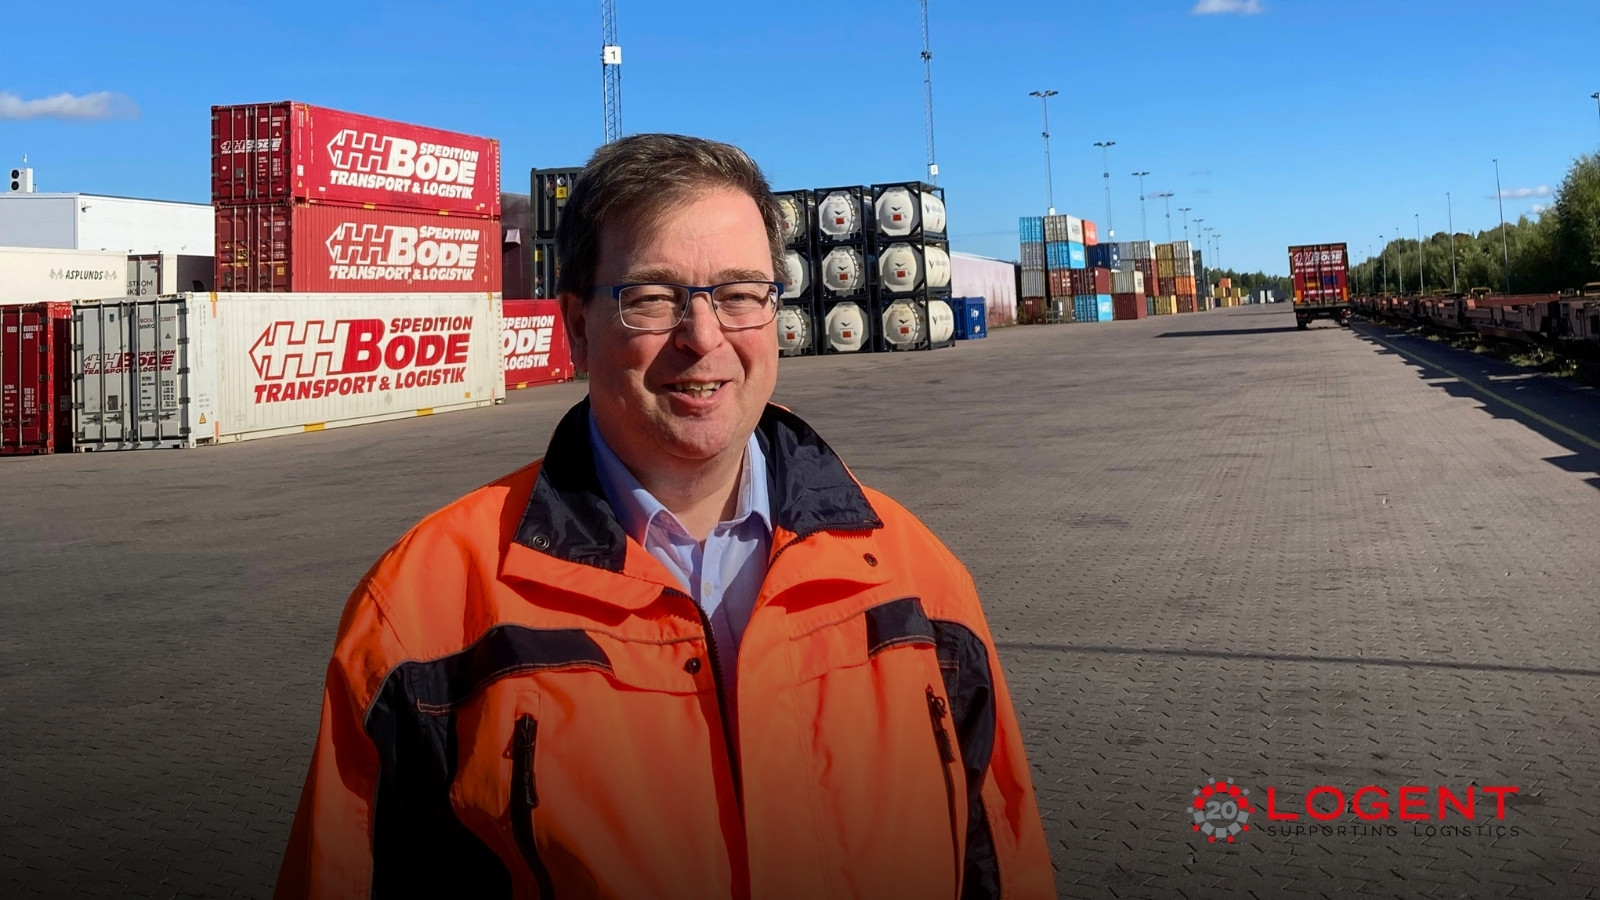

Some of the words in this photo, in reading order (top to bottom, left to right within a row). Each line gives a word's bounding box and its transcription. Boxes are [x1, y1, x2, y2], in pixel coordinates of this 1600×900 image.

[419, 142, 480, 163] SPEDITION
[330, 170, 411, 193] TRANSPORT
[411, 183, 421, 194] &
[423, 181, 474, 200] LOGISTIK
[419, 225, 480, 241] SPEDITION
[65, 269, 104, 280] ASPLUNDS
[329, 265, 411, 280] TRANSPORT
[413, 269, 422, 280] &
[423, 268, 475, 281] LOGISTIK
[390, 316, 473, 334] SPEDITION
[502, 327, 553, 357] ODE
[504, 353, 550, 370] LOGISTIK
[254, 375, 377, 404] TRANSPORT
[379, 375, 391, 391] &
[395, 367, 466, 389] LOGISTIK
